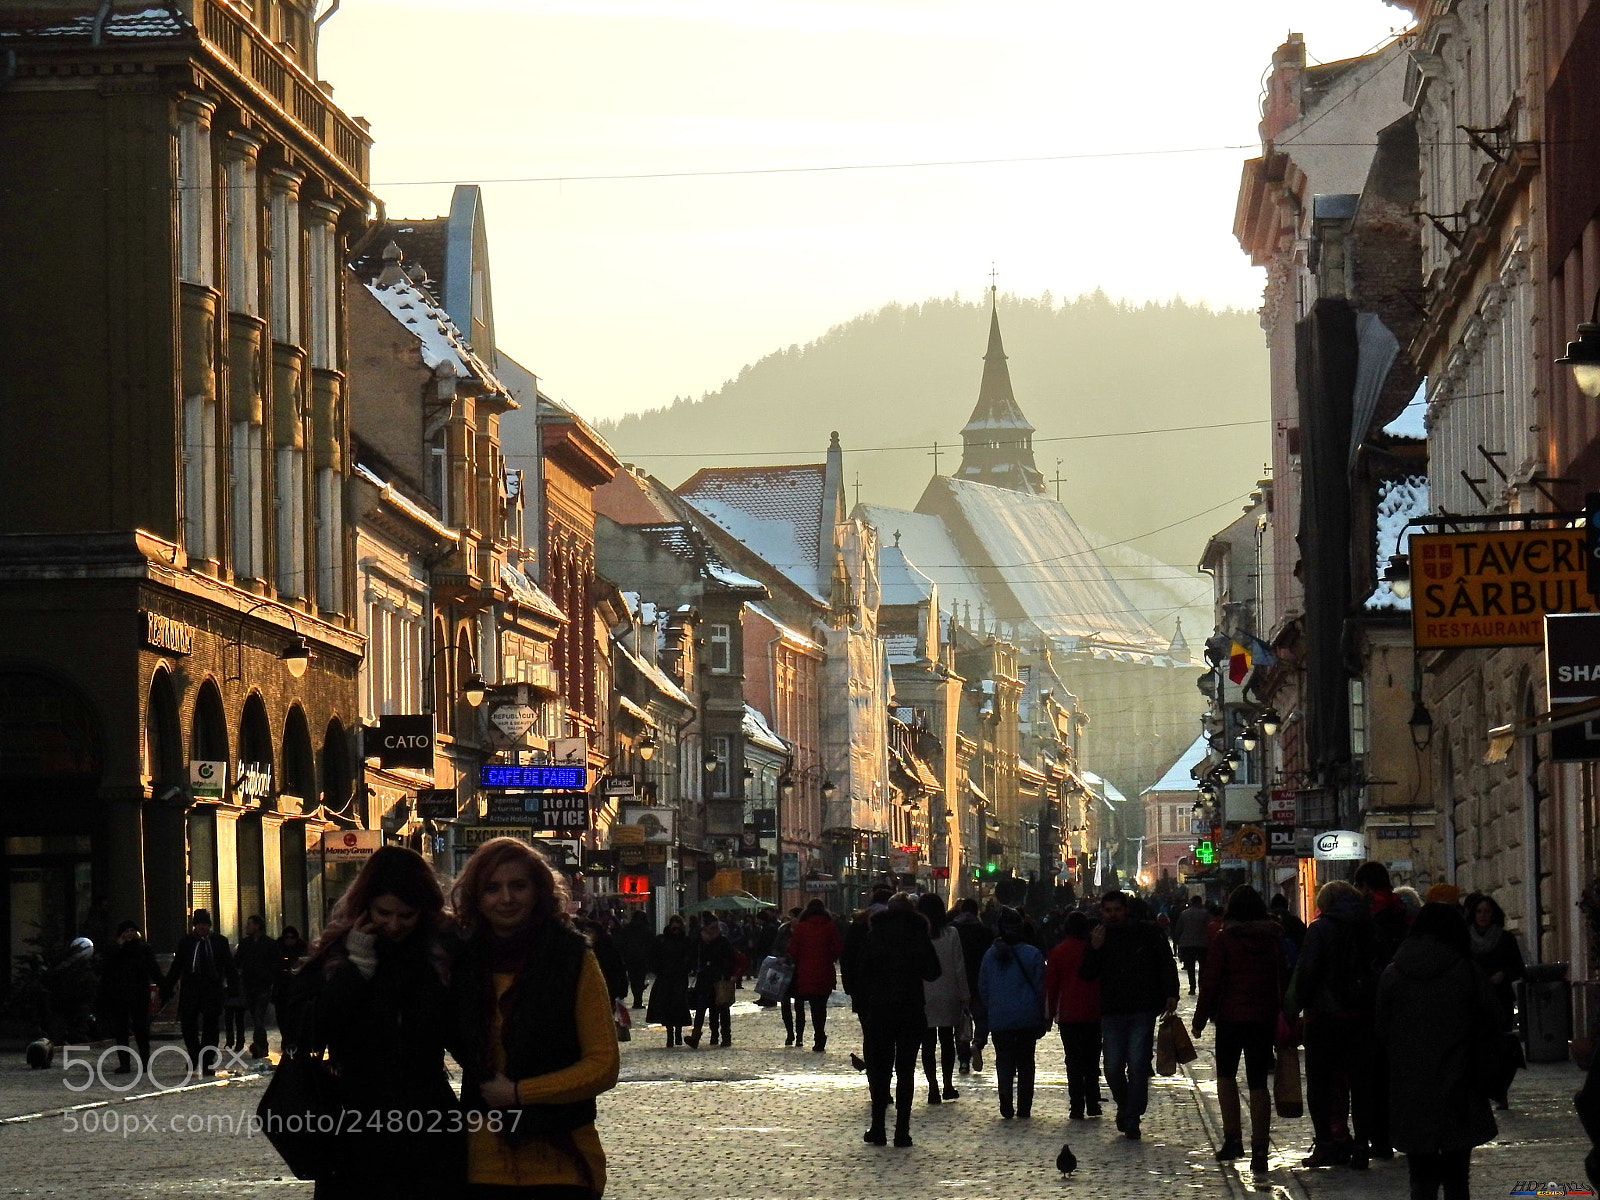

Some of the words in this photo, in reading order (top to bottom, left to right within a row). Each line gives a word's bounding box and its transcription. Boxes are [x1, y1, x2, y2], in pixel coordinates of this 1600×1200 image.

[1425, 576, 1600, 617] SÂRBUL
[1427, 620, 1540, 638] RESTAURANT
[384, 735, 429, 750] CATO
[488, 769, 521, 784] CAFE
[523, 770, 540, 785] DE
[542, 771, 576, 786] PARIS
[563, 811, 585, 825] ICE
[326, 846, 373, 856] MoneyGram
